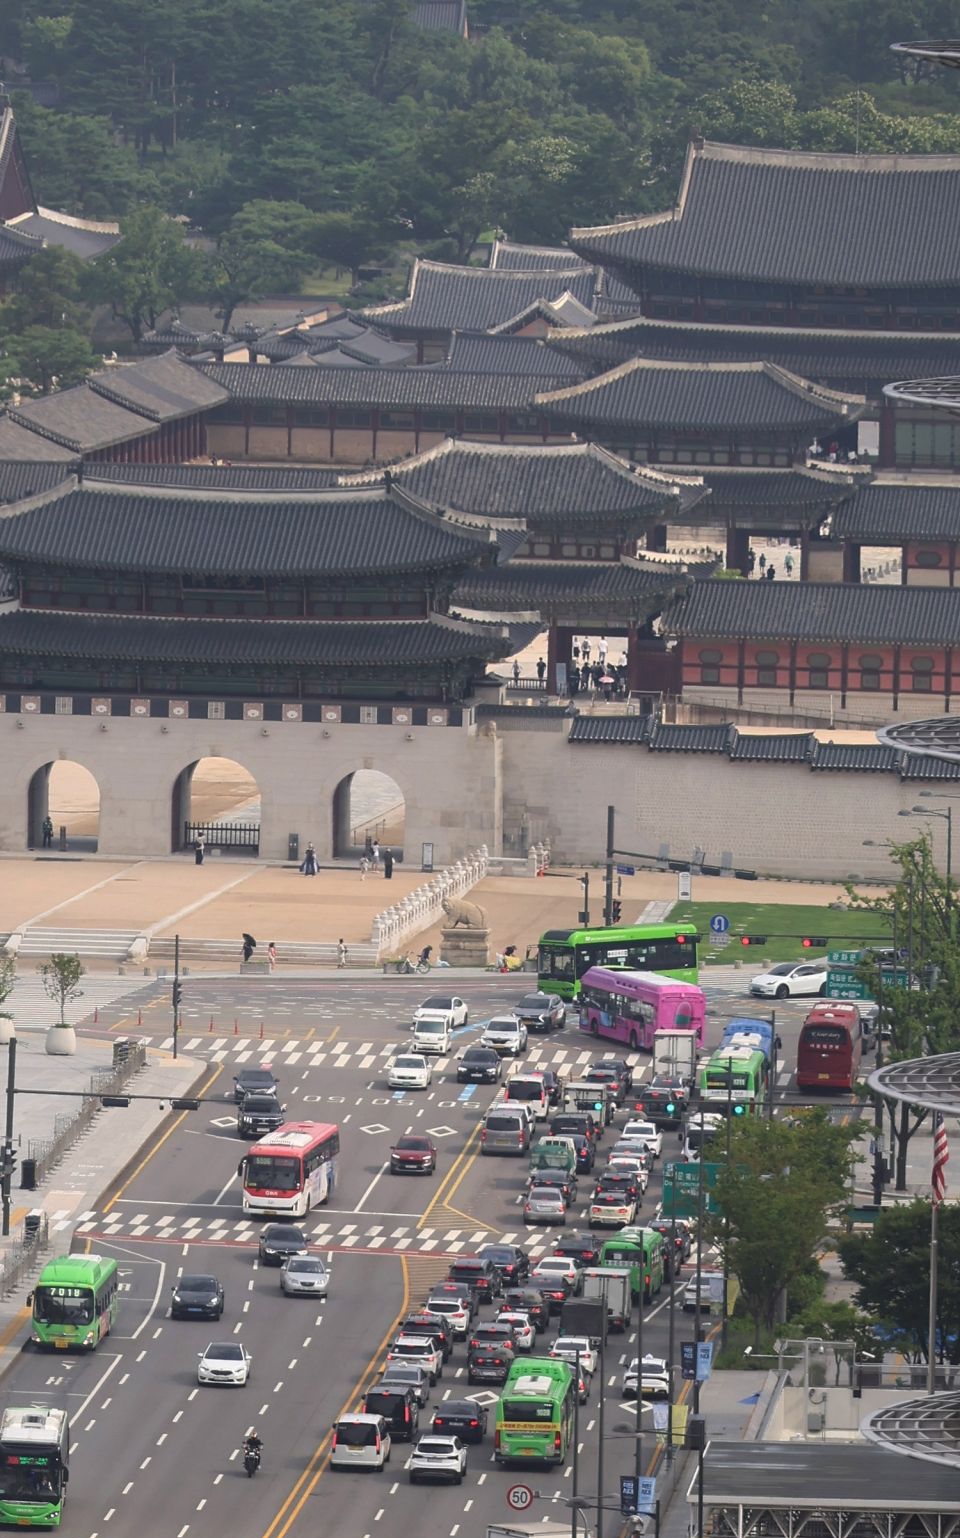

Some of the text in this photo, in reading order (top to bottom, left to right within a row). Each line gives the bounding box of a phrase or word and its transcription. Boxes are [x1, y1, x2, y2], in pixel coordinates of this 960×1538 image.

[832, 953, 856, 961] 광화문
[50, 1287, 81, 1297] 7018
[512, 1491, 528, 1504] 50
